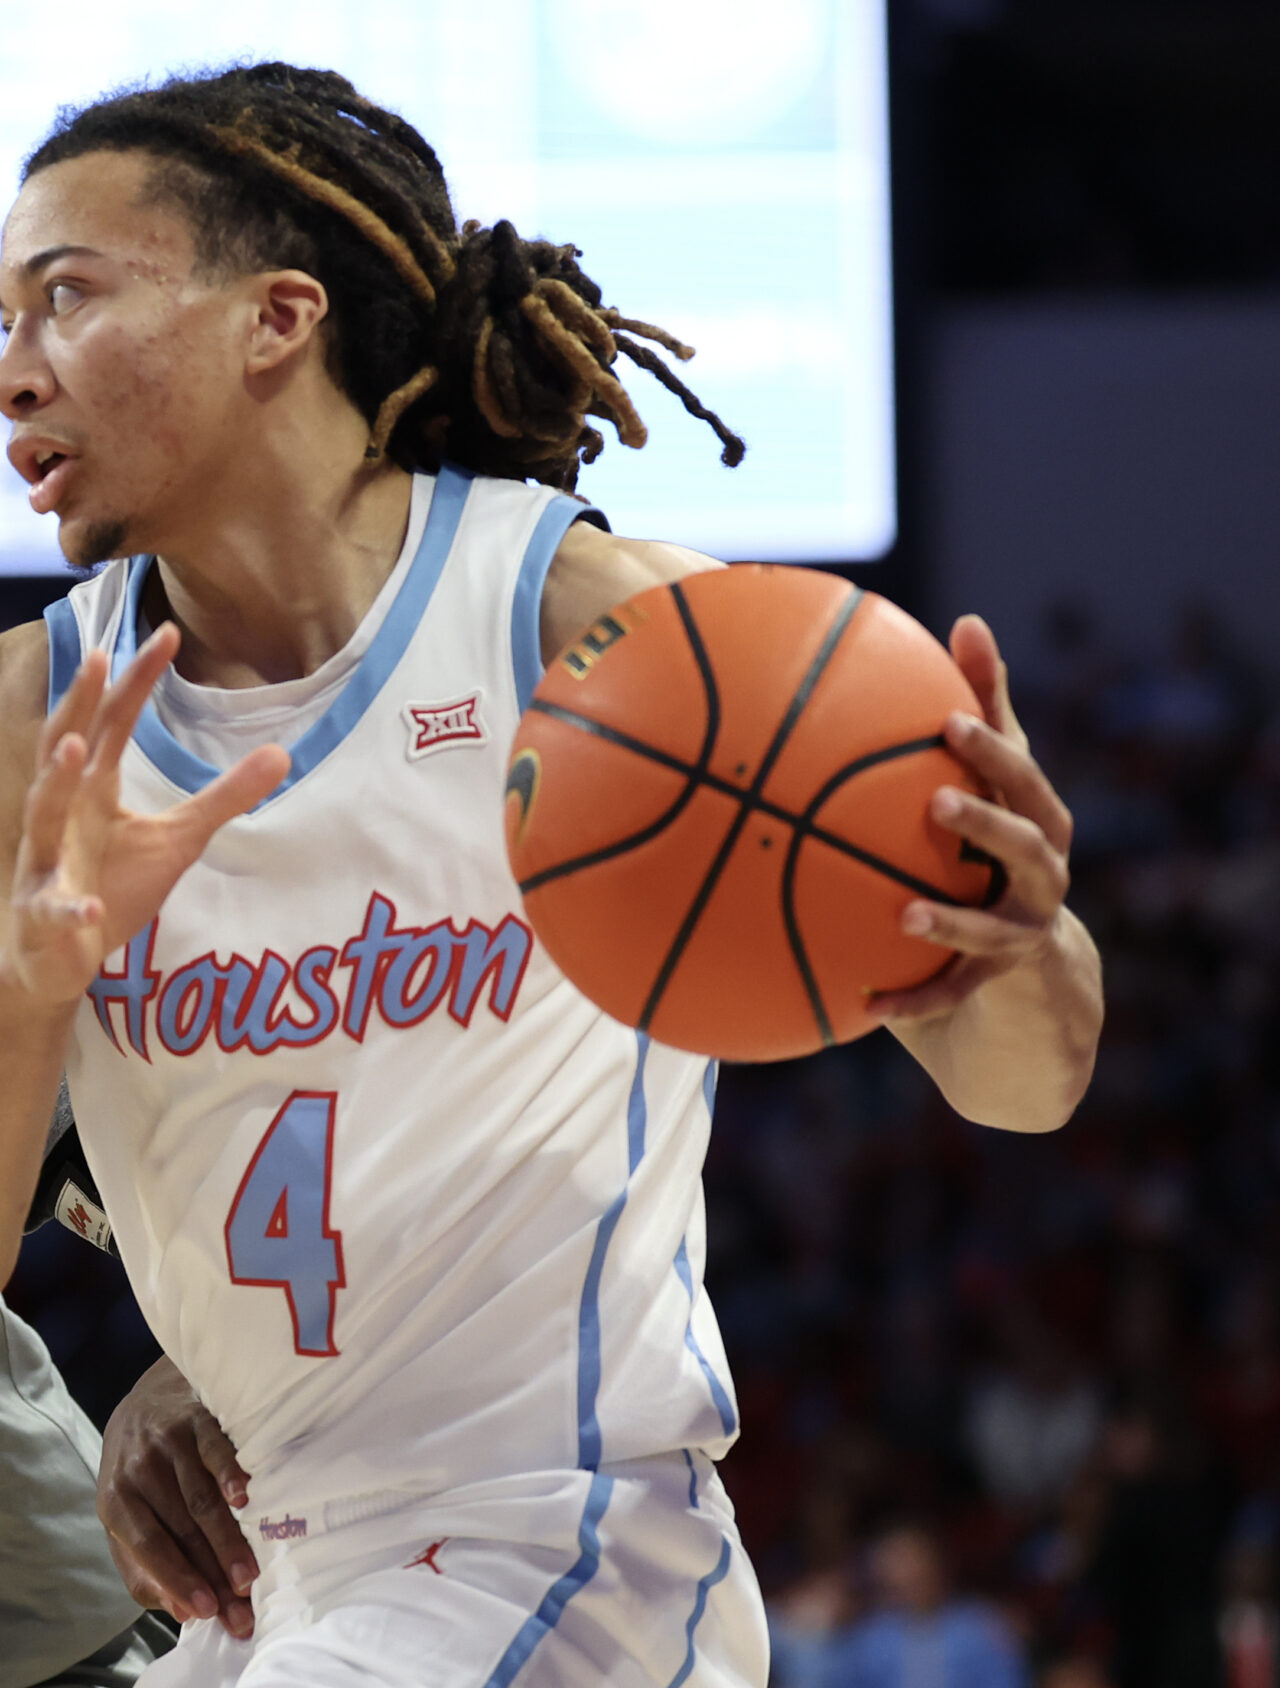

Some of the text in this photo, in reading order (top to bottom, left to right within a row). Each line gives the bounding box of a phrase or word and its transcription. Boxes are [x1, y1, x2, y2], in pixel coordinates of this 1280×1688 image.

[413, 700, 479, 745] XII
[86, 890, 534, 1064] Houston
[224, 1089, 347, 1357] 4
